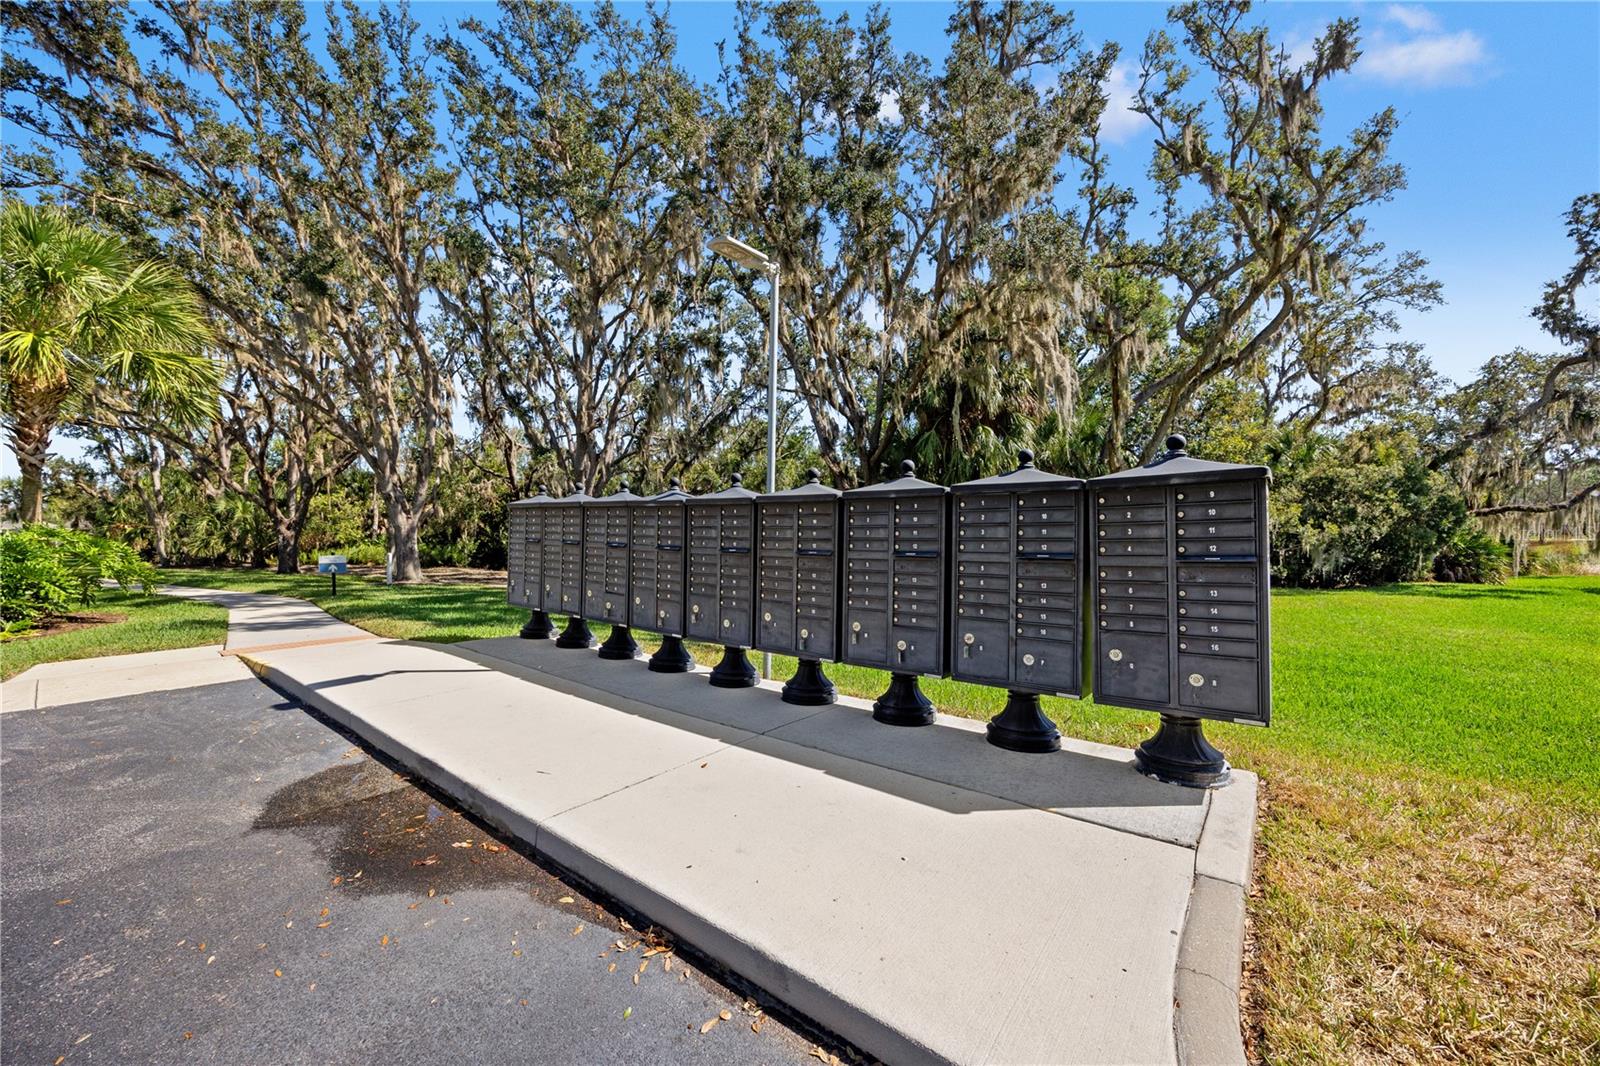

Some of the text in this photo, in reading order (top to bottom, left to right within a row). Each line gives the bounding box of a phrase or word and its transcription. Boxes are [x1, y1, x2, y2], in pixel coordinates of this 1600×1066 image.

[1209, 490, 1215, 498] 9
[1126, 511, 1132, 519] 2
[1207, 508, 1217, 516] 10
[1127, 528, 1133, 536] 3
[1208, 526, 1216, 534] 11
[1209, 544, 1217, 552] 12
[1127, 570, 1133, 578] 5
[1209, 589, 1218, 598] 13
[1129, 603, 1134, 611] 7
[1210, 607, 1219, 615] 14
[1129, 620, 1134, 628] 8
[1210, 625, 1219, 633] 15
[1210, 643, 1220, 652] 16
